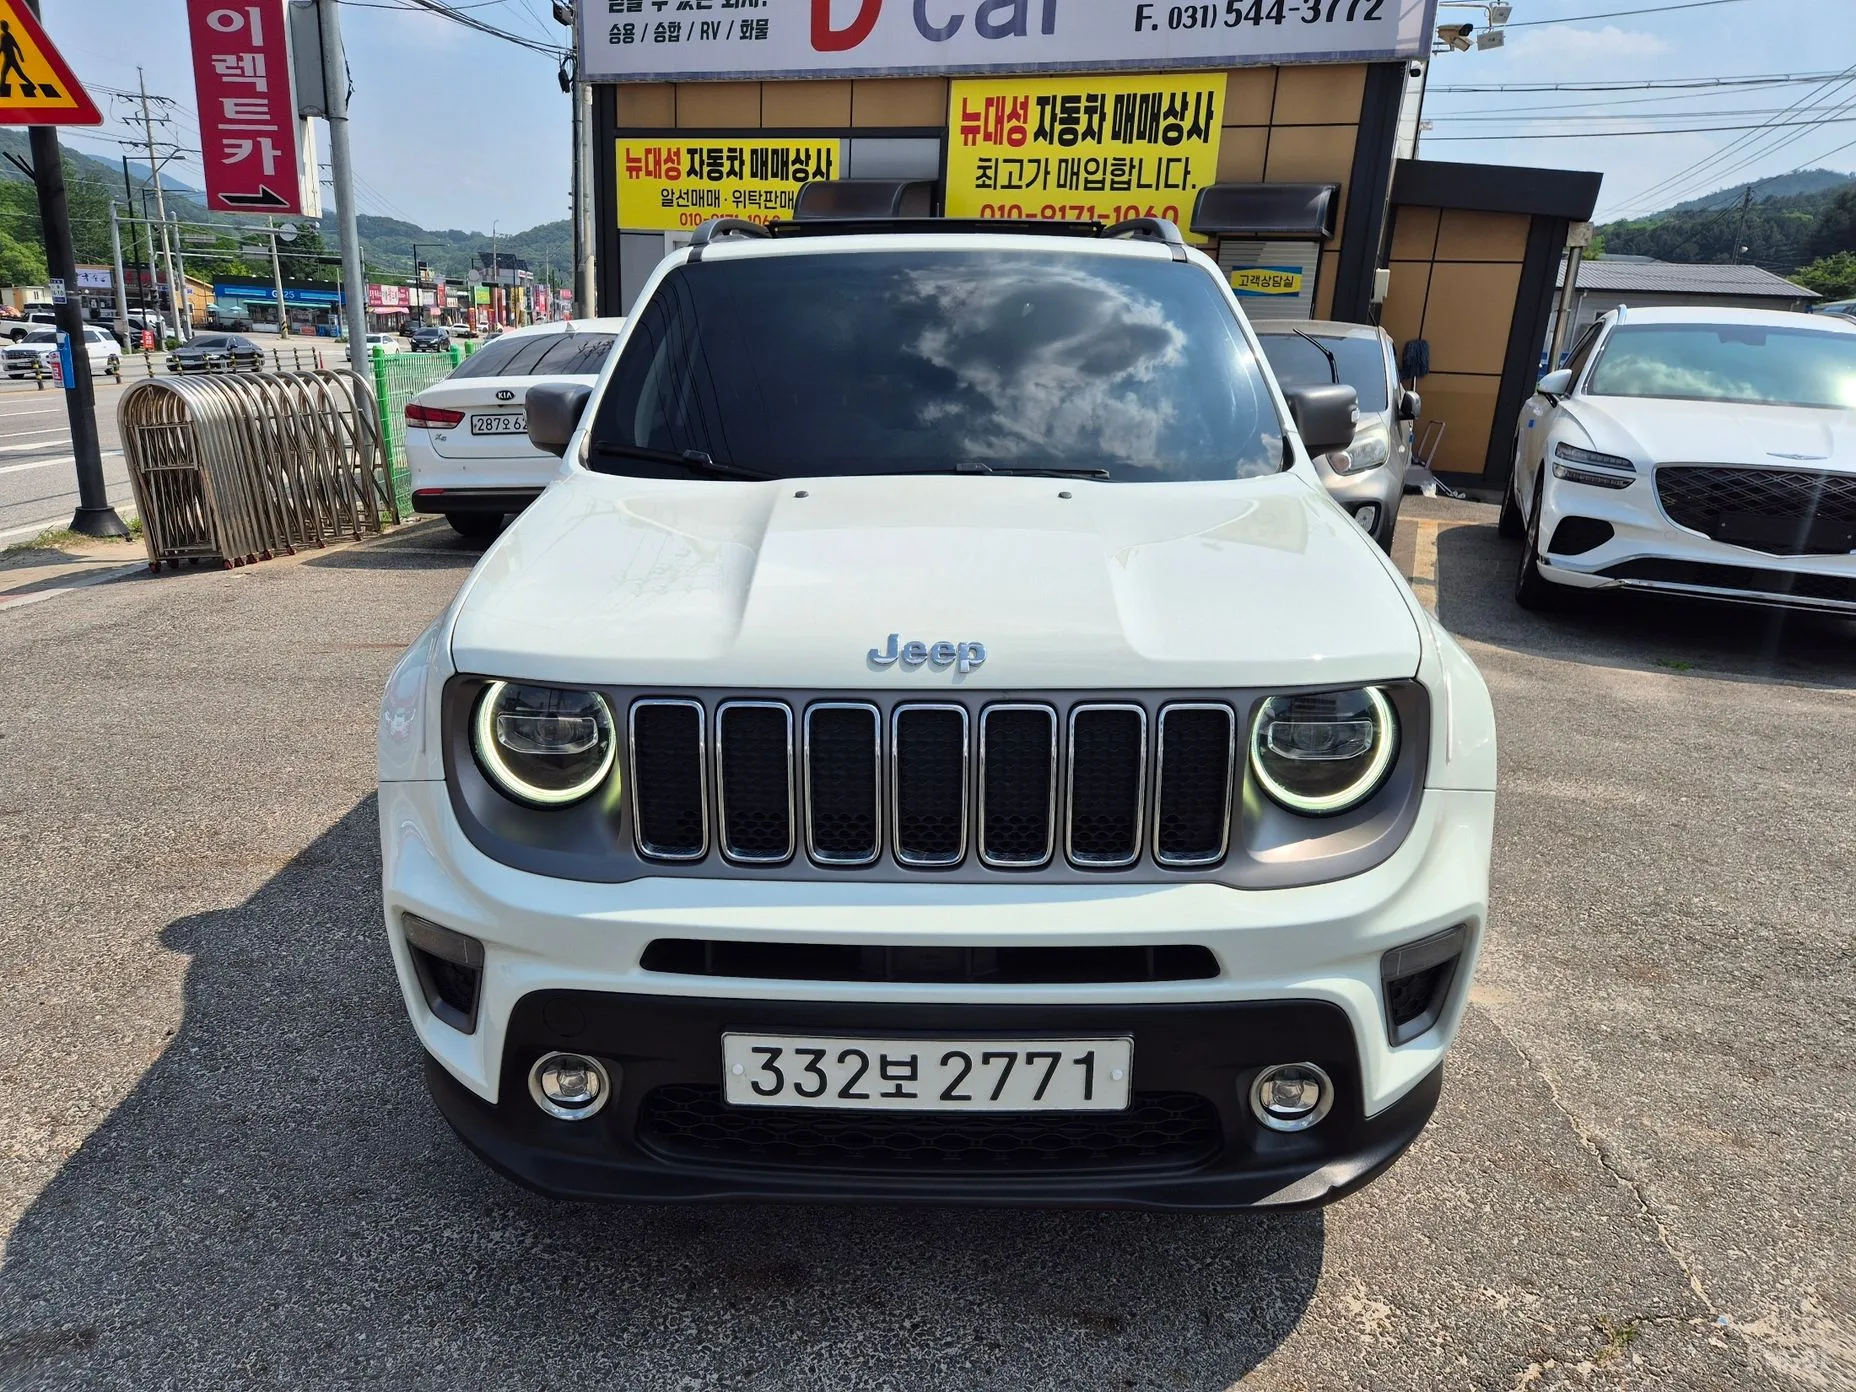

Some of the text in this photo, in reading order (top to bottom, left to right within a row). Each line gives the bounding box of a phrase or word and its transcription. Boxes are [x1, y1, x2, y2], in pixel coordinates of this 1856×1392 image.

[609, 23, 635, 44] 승용
[654, 21, 681, 43] 승합
[700, 21, 721, 40] RV
[739, 18, 769, 40] 화물
[1135, 4, 1158, 31] F.
[1168, 5, 1217, 29] 031)
[206, 7, 282, 176] 이렉트카
[960, 90, 1215, 148] 뉴대성 자동차 매매상사
[625, 147, 833, 182] 뉴대성 자동차 매매상사
[975, 156, 1197, 191] 최고가 매입합니다.
[661, 188, 721, 208] 알선매매
[732, 189, 794, 210] 위탁판매
[271, 289, 295, 298] G25
[1239, 274, 1294, 288] 고객상담실
[477, 417, 510, 431] 287오
[867, 633, 988, 674] Jeep
[750, 1046, 1096, 1101] 332보 2771
